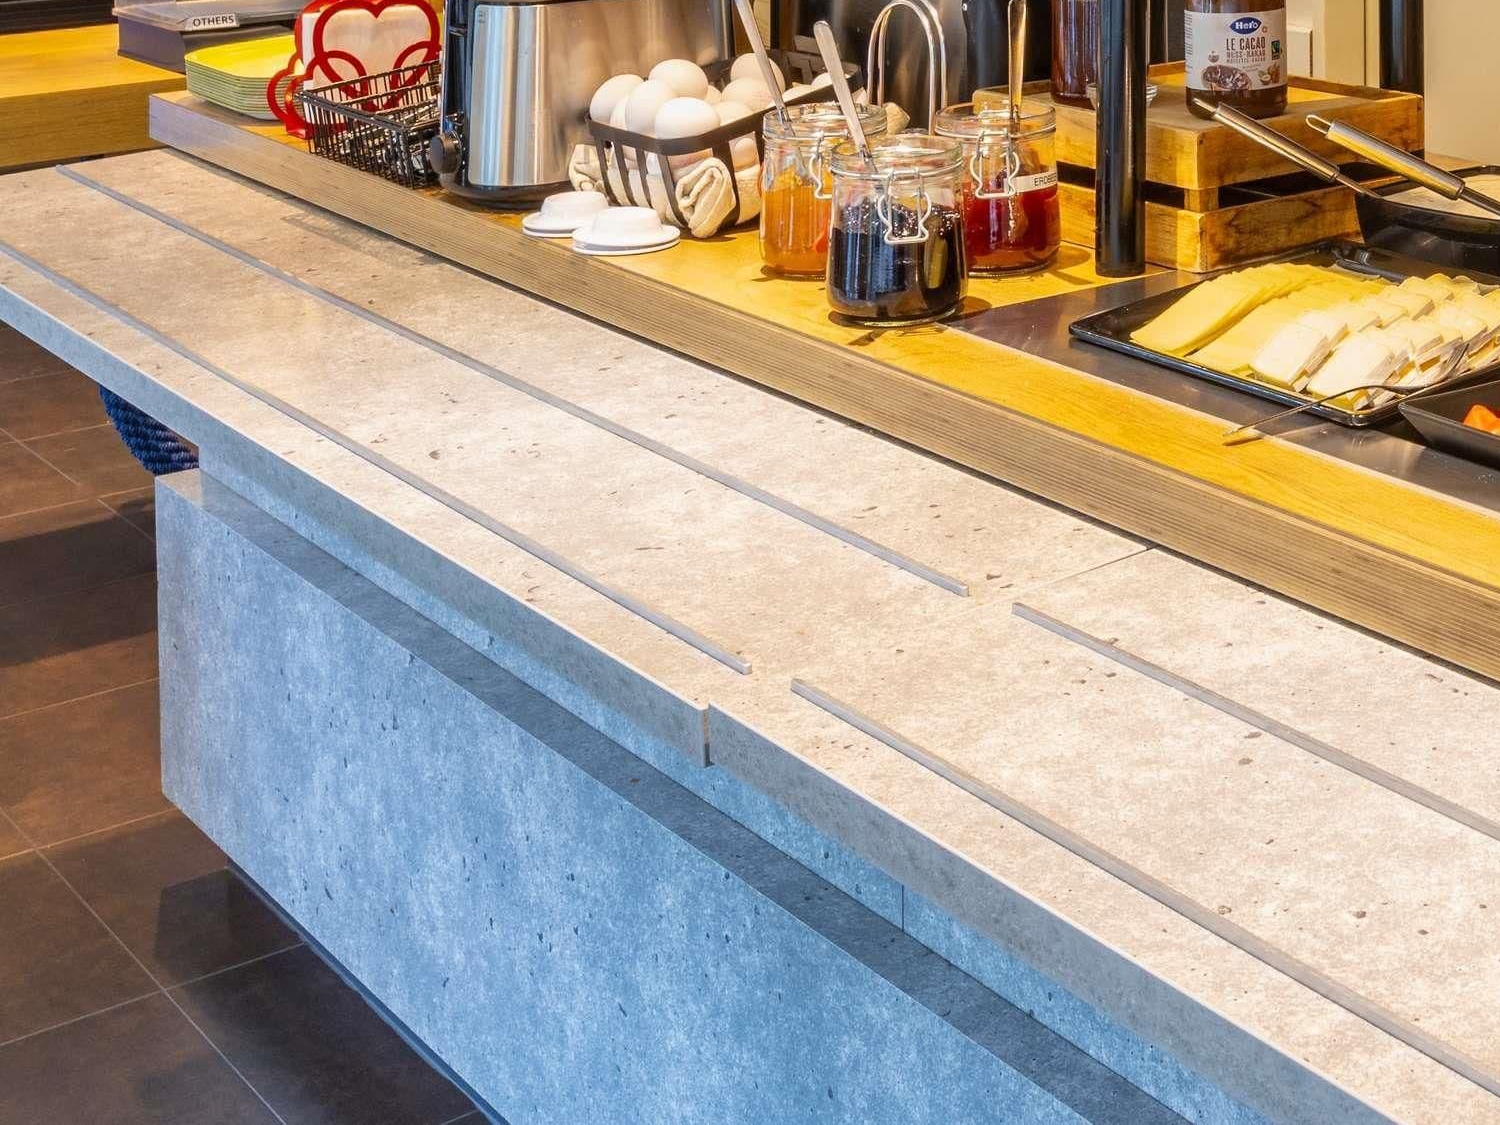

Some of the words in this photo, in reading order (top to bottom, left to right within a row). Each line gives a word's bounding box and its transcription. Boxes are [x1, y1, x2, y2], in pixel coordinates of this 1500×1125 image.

[193, 15, 235, 28] OTHERS
[1235, 20, 1259, 30] Hero
[1226, 37, 1236, 51] LE
[1239, 36, 1266, 51] CACAO
